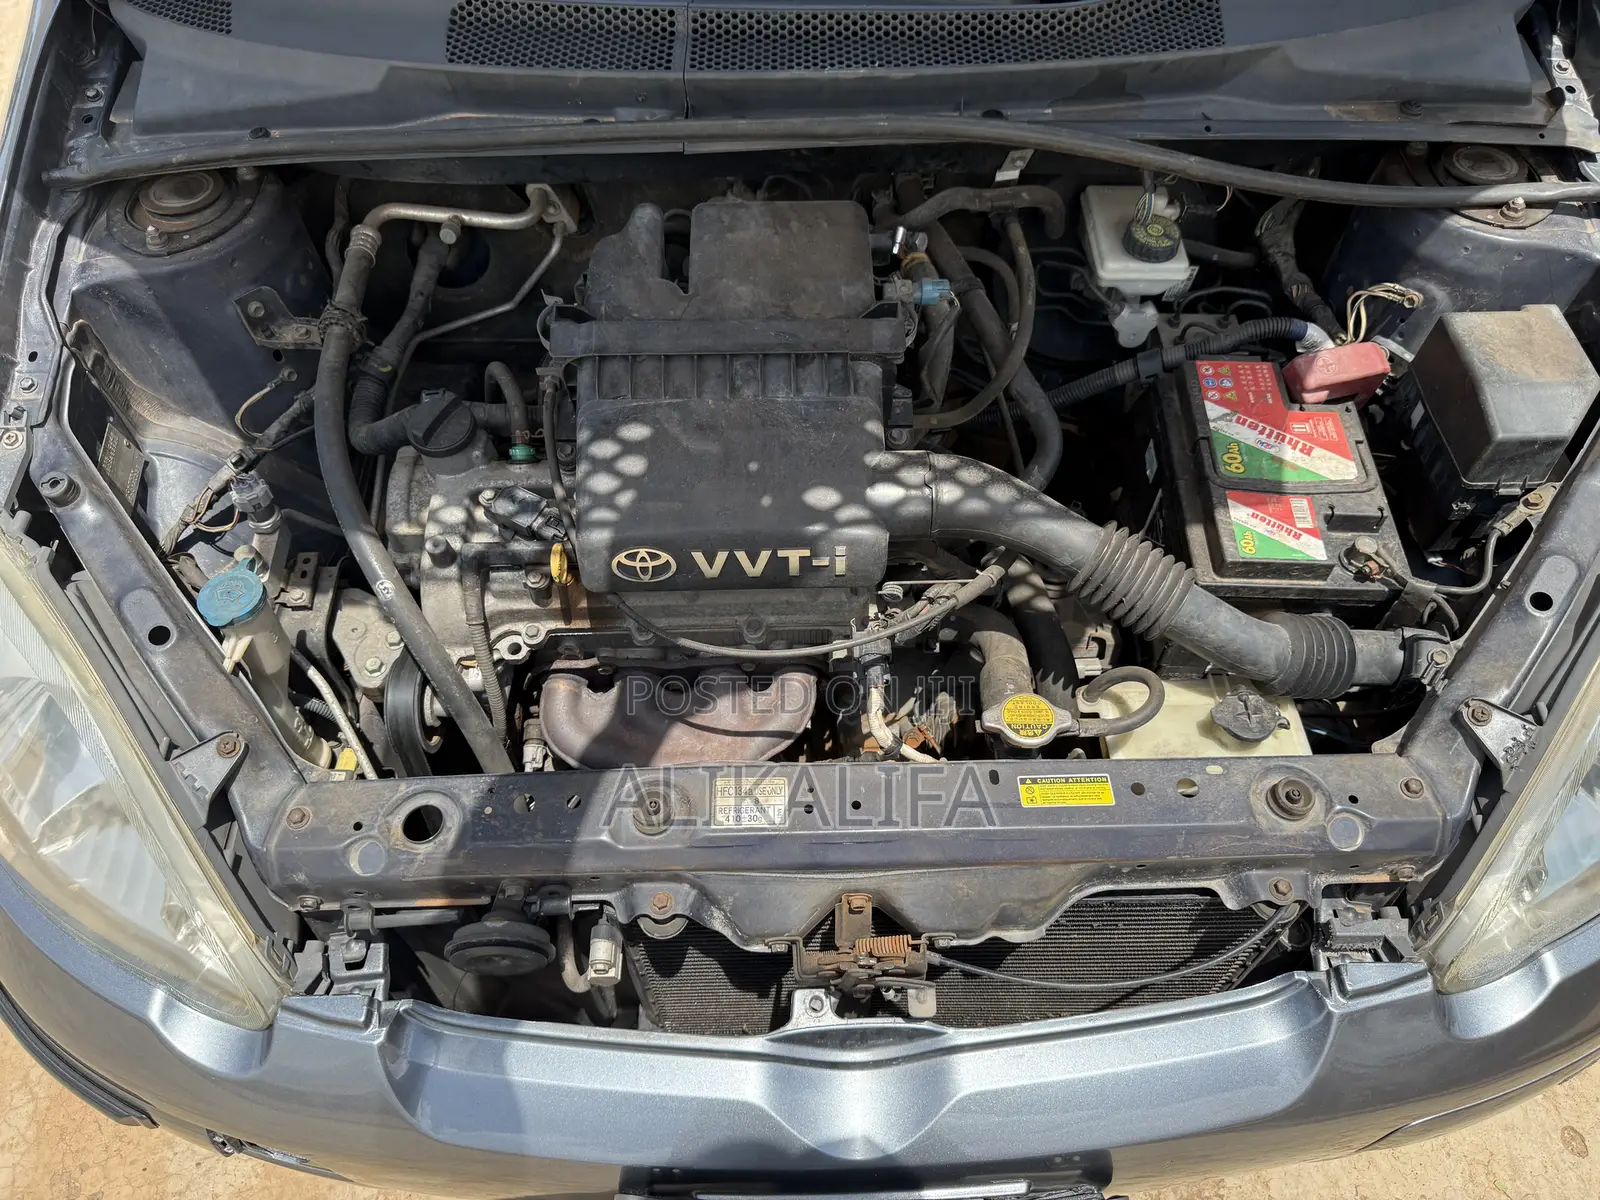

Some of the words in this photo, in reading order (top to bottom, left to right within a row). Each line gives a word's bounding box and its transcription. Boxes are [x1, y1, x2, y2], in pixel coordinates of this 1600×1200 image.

[1234, 415, 1315, 457] Rhütten
[1222, 442, 1245, 473] 60Ah
[1250, 511, 1303, 541] Rhütten
[1240, 531, 1256, 554] 60Ah
[691, 545, 847, 579] VVT-i
[718, 806, 771, 815] REFRIGERANT
